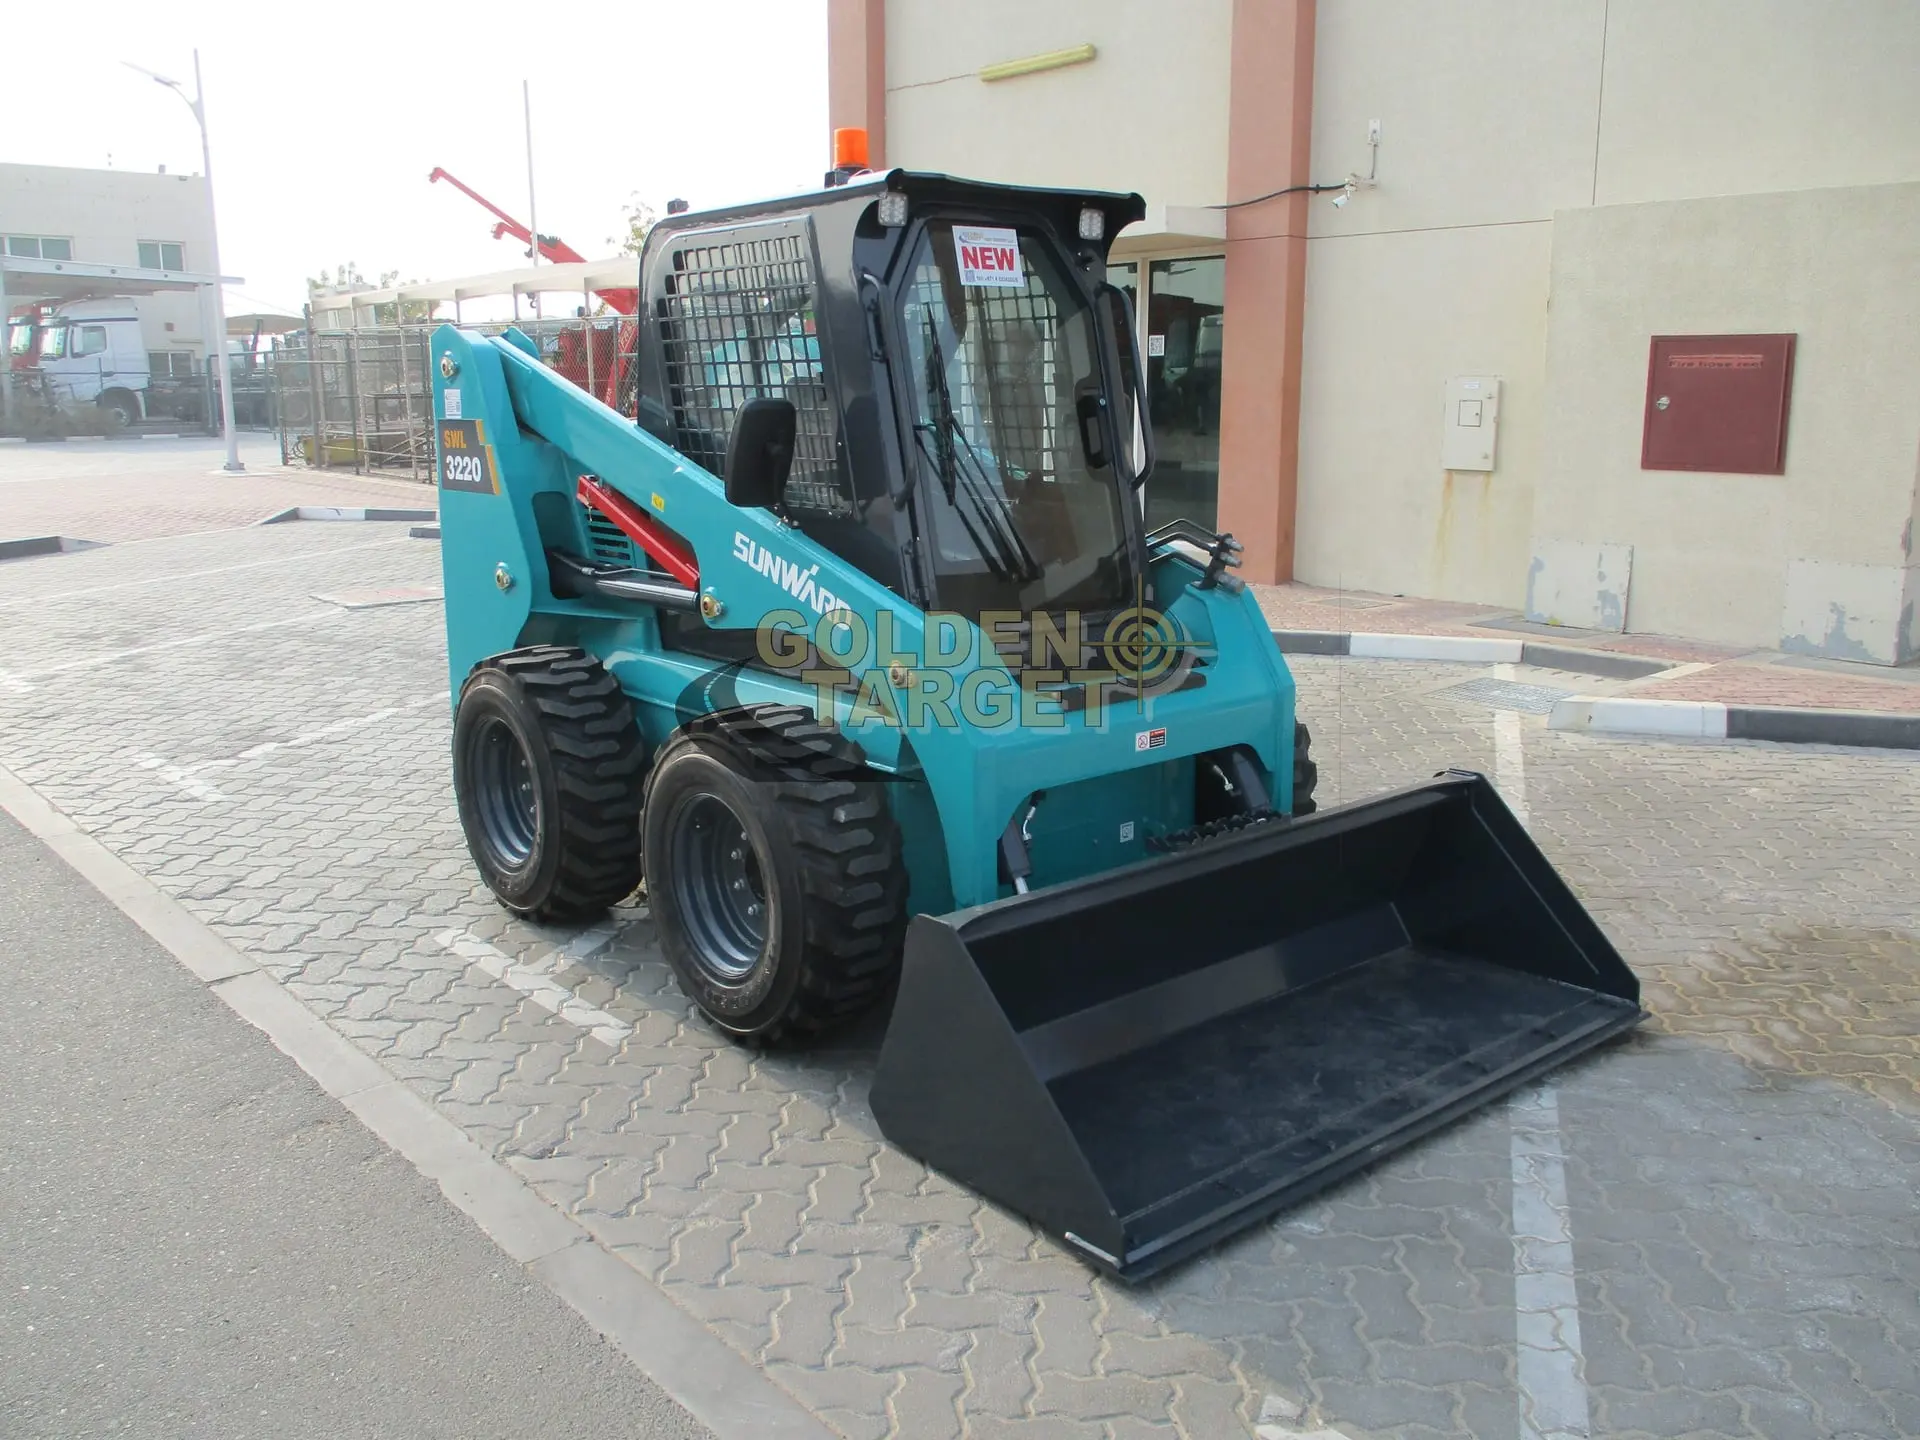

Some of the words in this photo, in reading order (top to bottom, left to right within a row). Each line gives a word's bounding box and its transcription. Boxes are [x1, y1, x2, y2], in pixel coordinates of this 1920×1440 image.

[961, 246, 1015, 271] NEW
[1669, 360, 1694, 368] Fire
[1698, 360, 1733, 368] hose
[443, 430, 467, 448] SWL
[446, 455, 482, 482] 3220
[733, 531, 852, 630] SUNWARD
